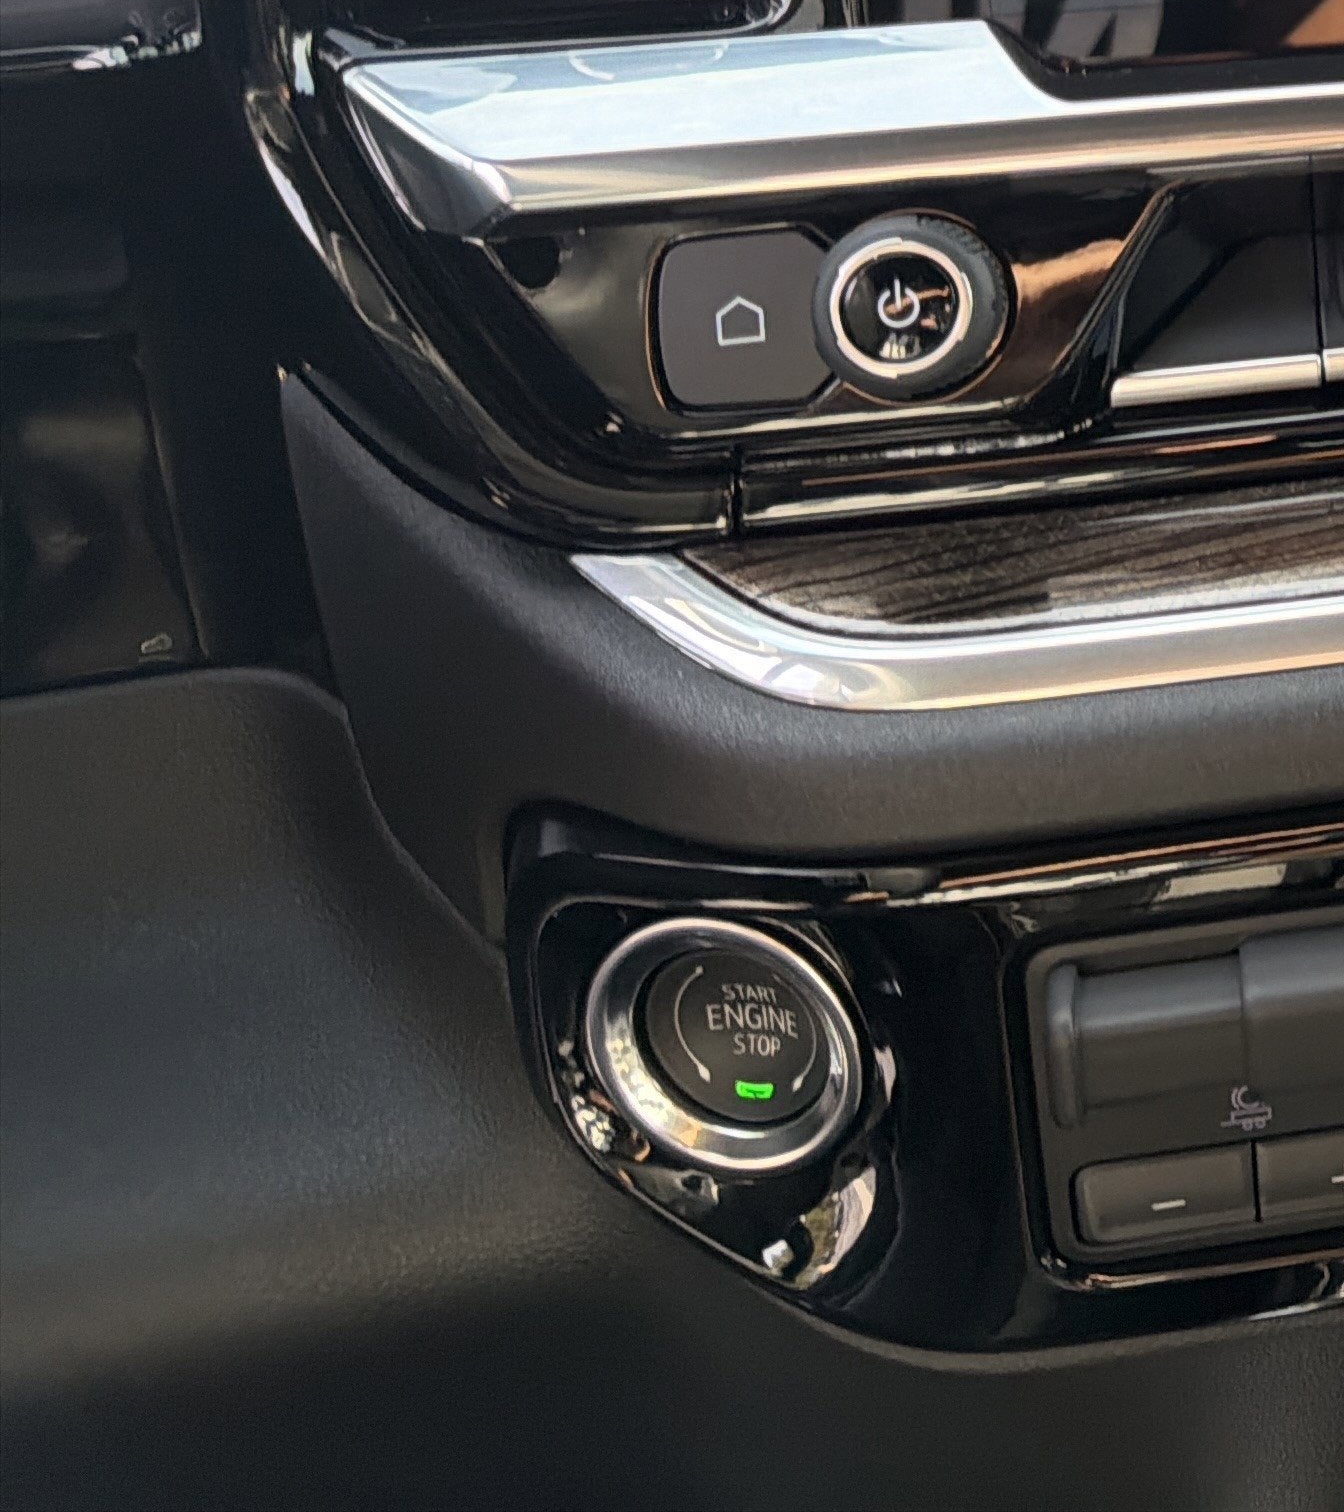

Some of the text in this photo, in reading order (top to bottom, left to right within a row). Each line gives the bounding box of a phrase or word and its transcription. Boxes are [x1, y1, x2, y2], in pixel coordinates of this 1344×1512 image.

[721, 982, 777, 1005] START
[705, 1001, 799, 1039] ENGINE
[733, 1032, 781, 1057] STOP
